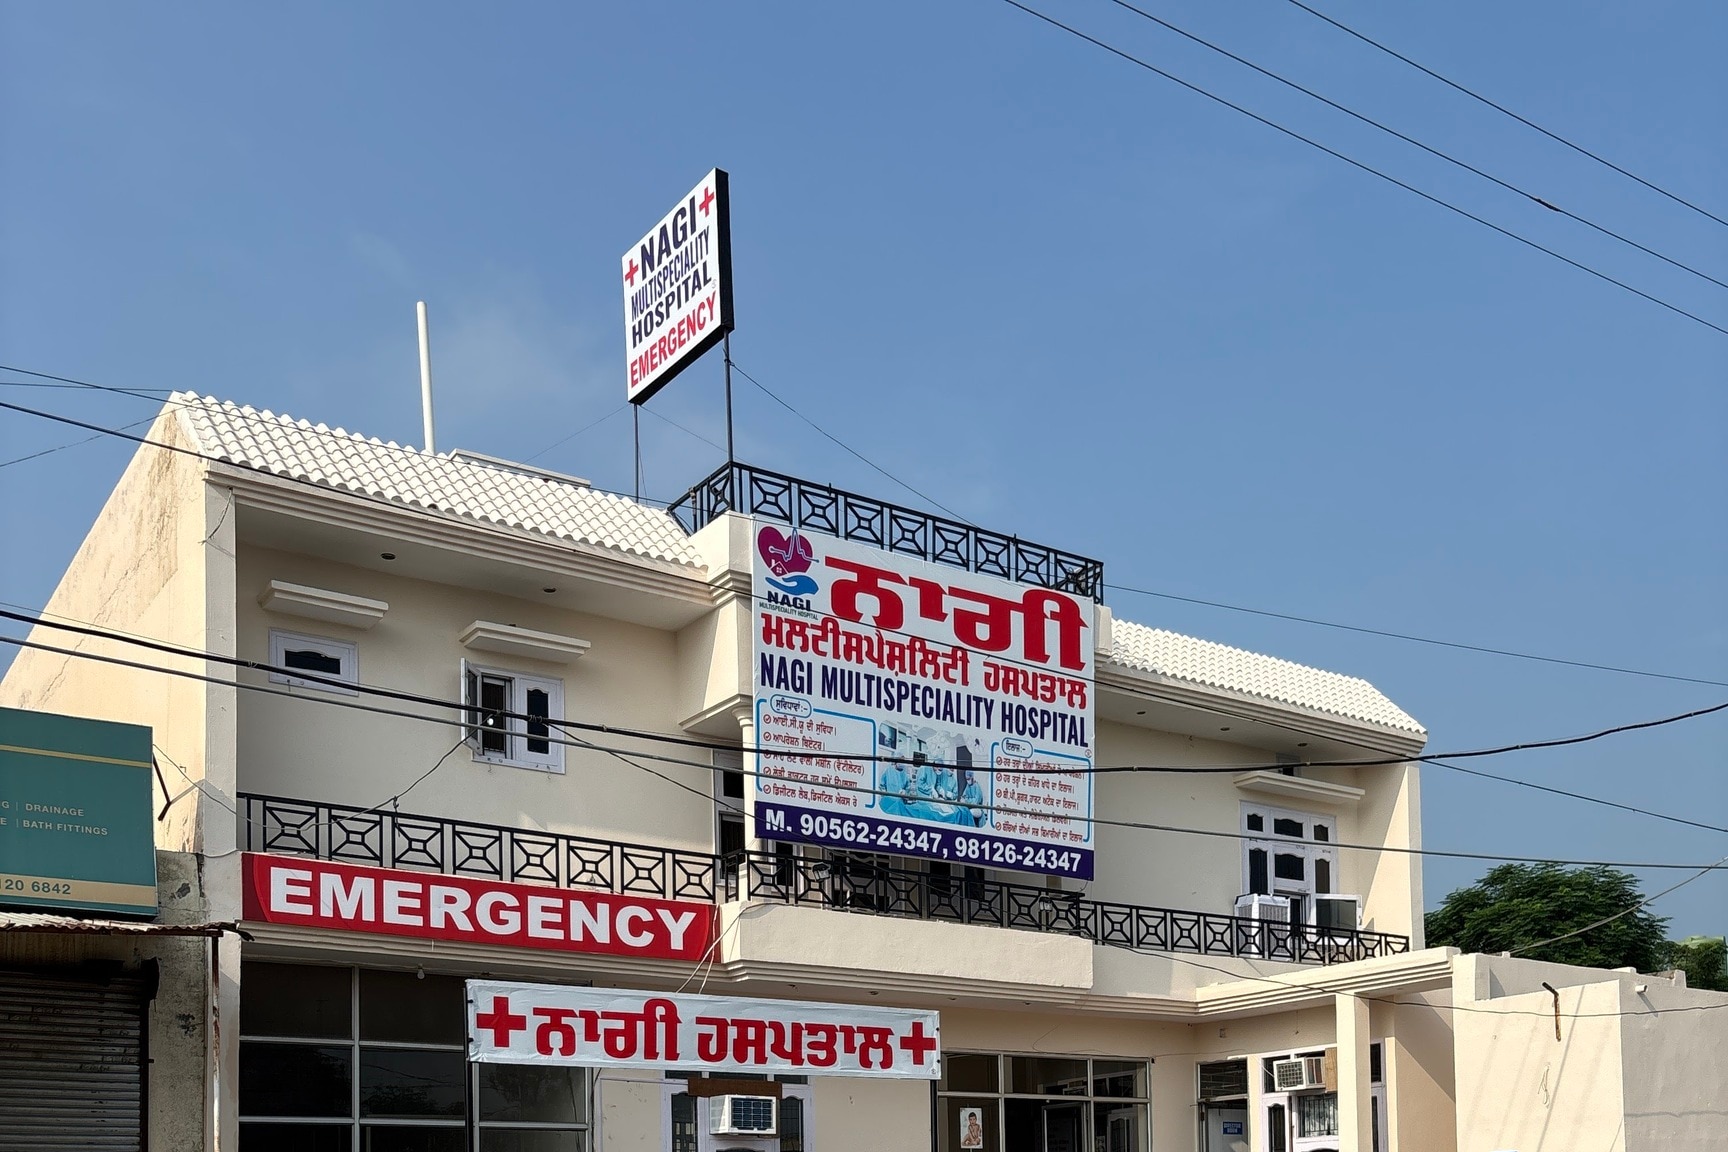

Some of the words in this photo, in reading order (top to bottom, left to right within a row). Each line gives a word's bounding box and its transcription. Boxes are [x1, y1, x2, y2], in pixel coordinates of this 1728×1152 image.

[640, 195, 696, 281] NAGI
[631, 225, 710, 322] MULTISPECIALITY
[632, 260, 712, 349] HOSPITAL
[630, 290, 716, 388] EMERGENCY
[759, 601, 797, 615] MULTISPECIALITY
[797, 609, 819, 621] HOSPITAL
[767, 590, 811, 611] NAGI
[824, 556, 1089, 671] ਨਾਗੀ
[760, 652, 813, 696] NAGI
[821, 664, 995, 730] MULTISPECIALITY
[1001, 701, 1089, 748] HOSPITAL
[983, 661, 1088, 710] ਹਸਪਤਾਲ
[806, 719, 814, 731] ਦੀ
[23, 819, 53, 830] BATH
[57, 823, 108, 836] FITTINGS
[25, 803, 85, 817] DRAINAGE
[765, 809, 792, 833] M.
[801, 813, 948, 859] 90562-24347,
[955, 837, 1082, 873] 98126-24347
[31, 881, 71, 895] 6842
[269, 866, 697, 951] EMERGENCY
[532, 998, 683, 1061] ਨਾਗੀ
[695, 1016, 896, 1070] ਹਸਪਤਾਲ
